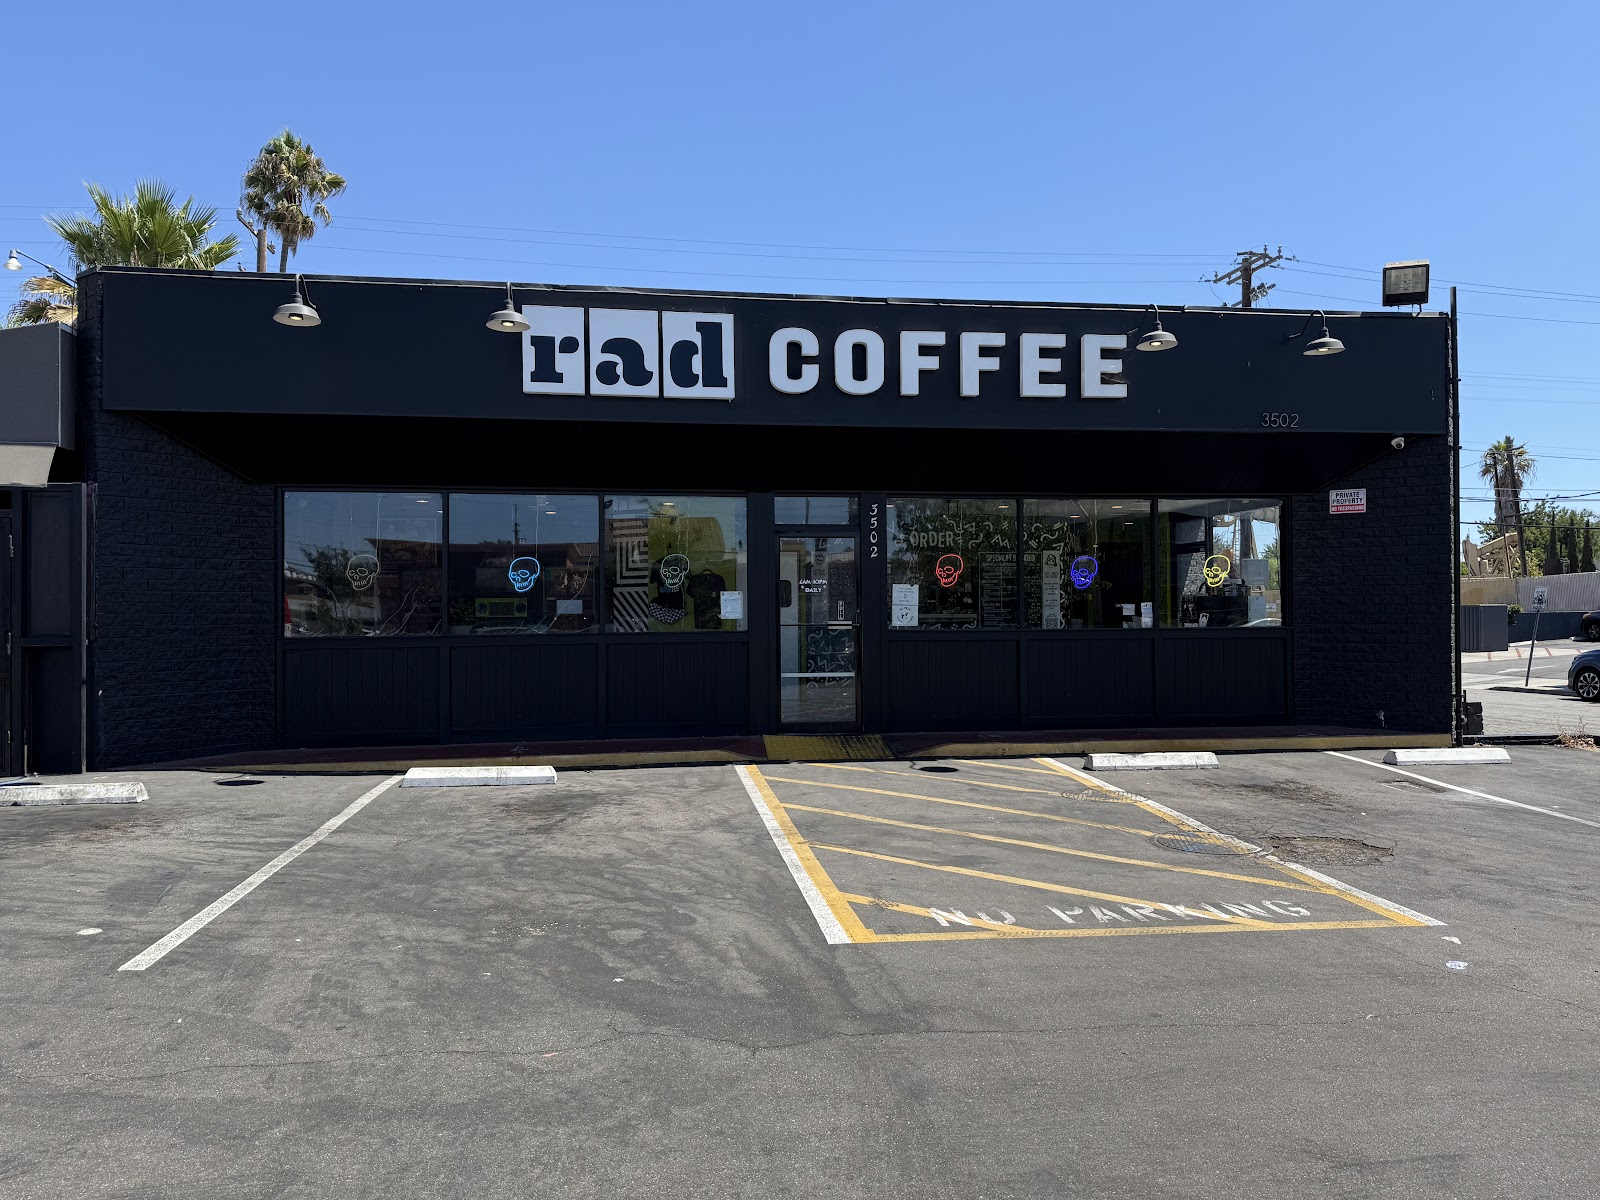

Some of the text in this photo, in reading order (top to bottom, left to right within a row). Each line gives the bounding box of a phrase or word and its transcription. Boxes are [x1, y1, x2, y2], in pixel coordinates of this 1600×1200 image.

[529, 321, 1129, 399] rad COFFEE
[1261, 412, 1299, 428] 3502
[869, 503, 879, 559] 3502
[909, 530, 955, 548] ORDER
[927, 899, 1312, 928] NO PARKING
